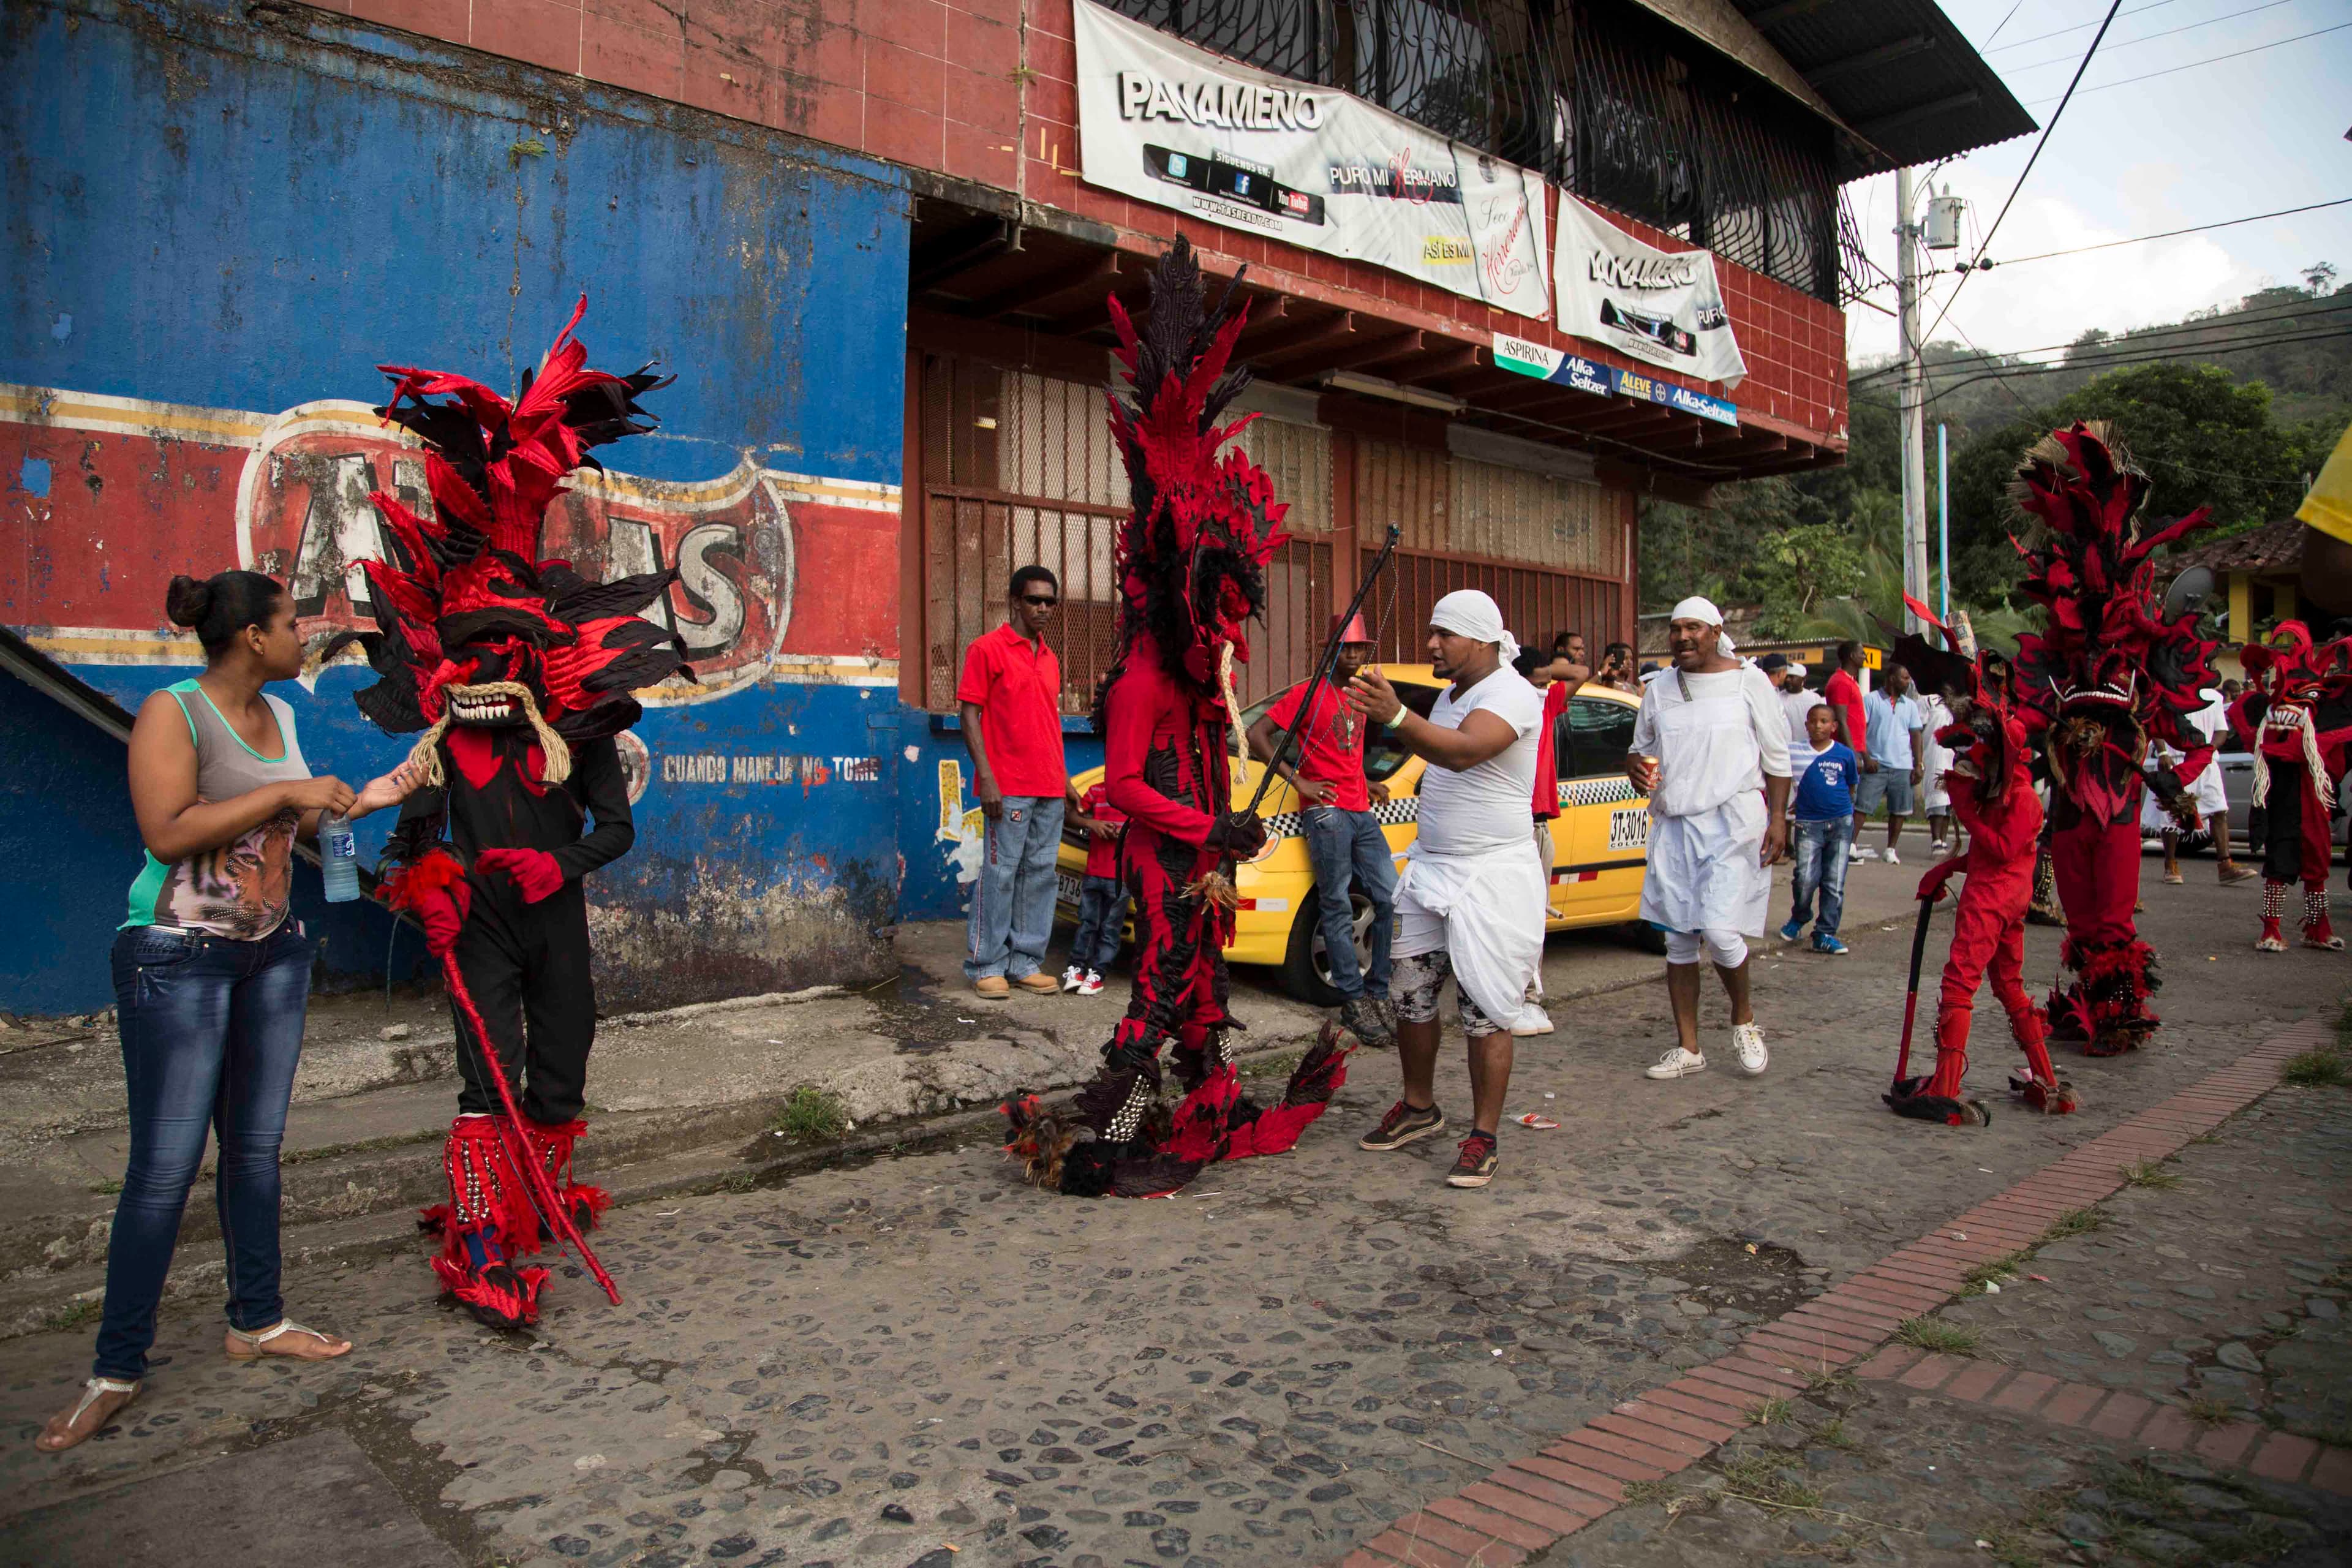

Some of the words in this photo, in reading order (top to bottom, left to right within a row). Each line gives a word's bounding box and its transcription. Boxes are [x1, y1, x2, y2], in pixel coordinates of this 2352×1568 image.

[1330, 167, 1371, 185] PURO
[1373, 168, 1389, 186] MI
[1442, 243, 1455, 258] ES
[1457, 243, 1469, 258] MI
[1504, 340, 1548, 365] ASPIRINA
[1566, 356, 1596, 376] Alka-
[1570, 372, 1607, 395] Seltzer
[1620, 371, 1651, 393] ALEVE
[1673, 388, 1735, 423] Alka-Seltzer
[664, 755, 726, 782] CUANDO
[832, 756, 878, 782] TOME
